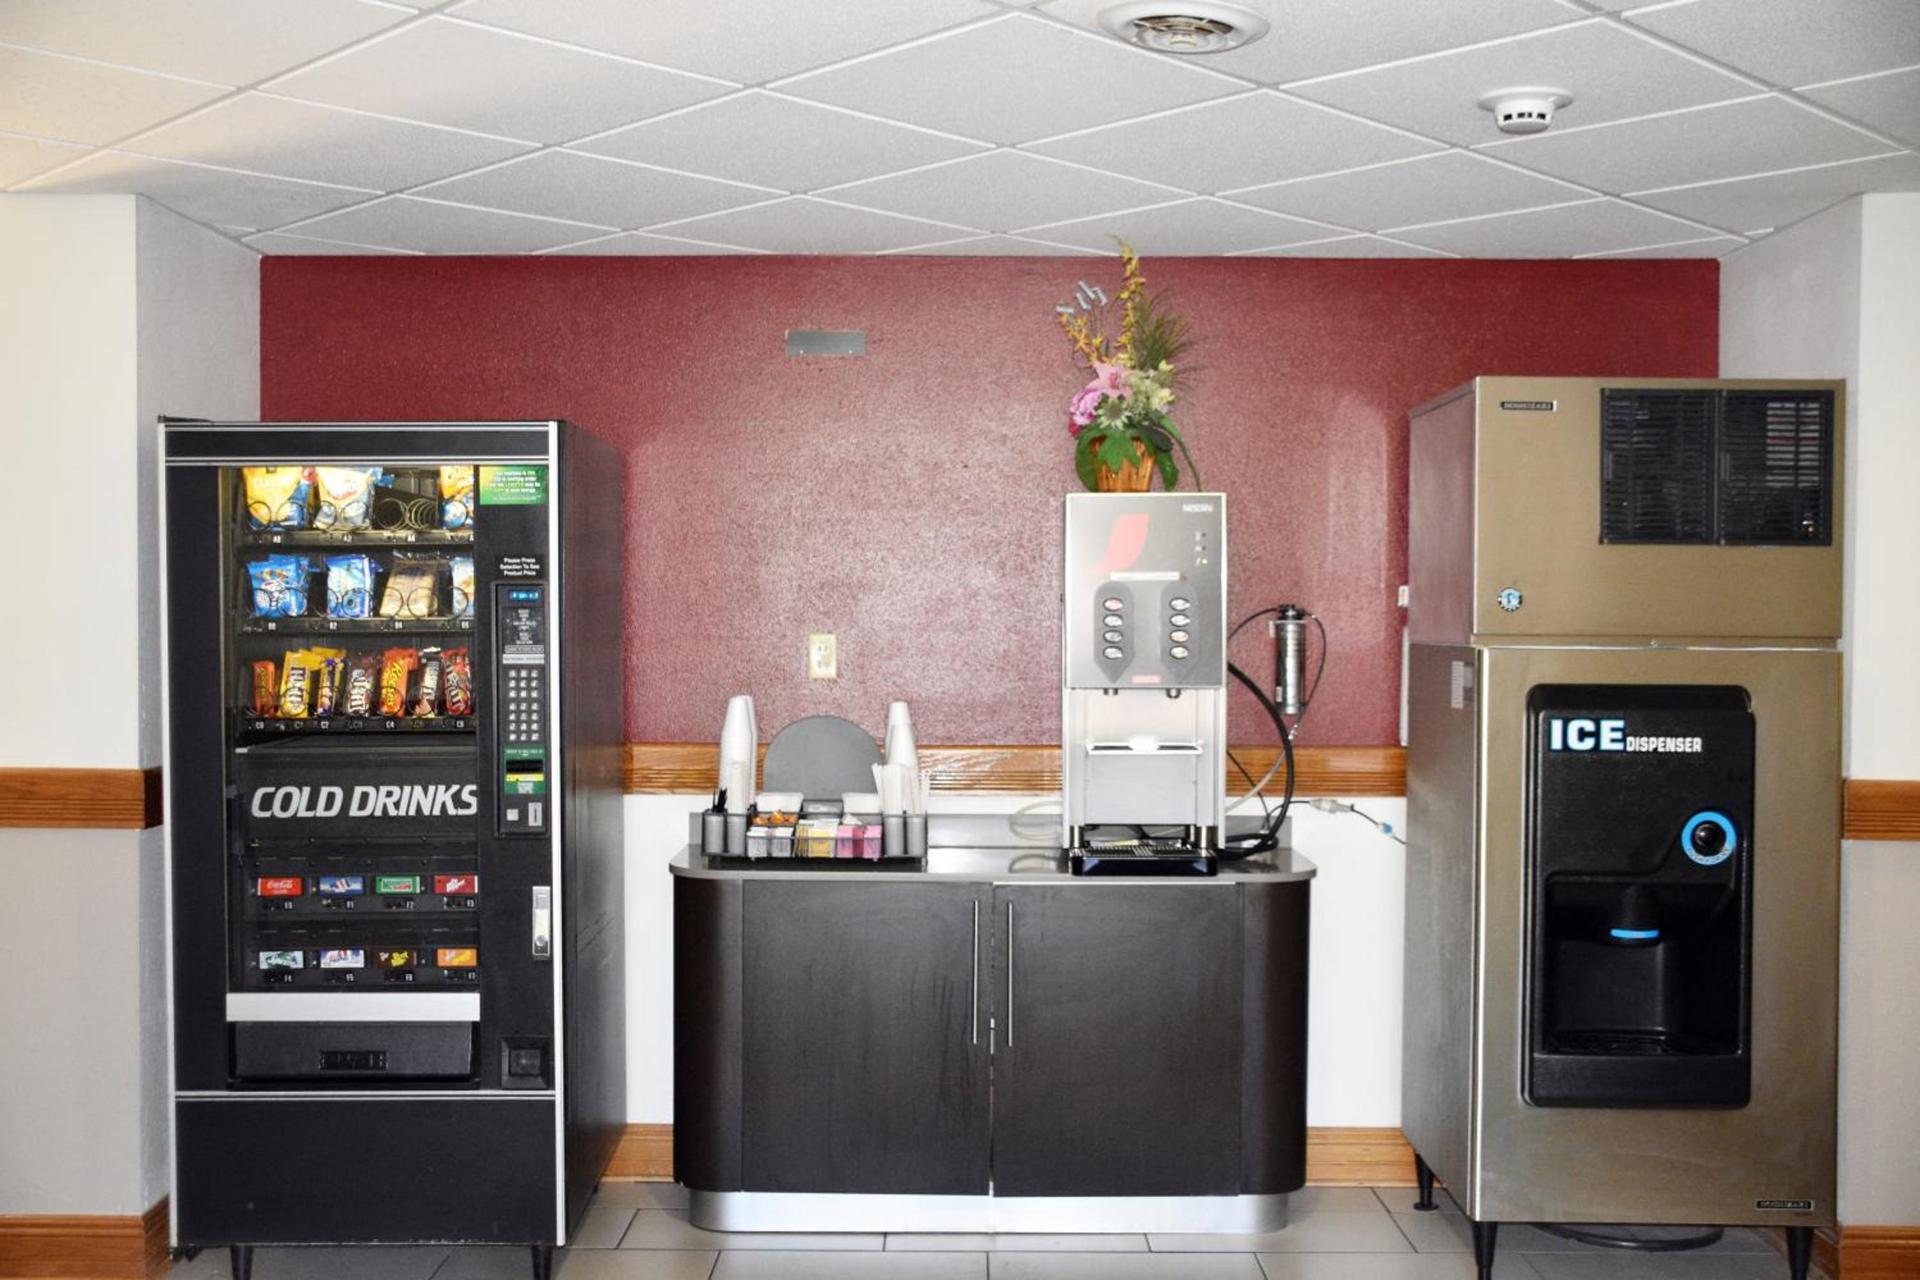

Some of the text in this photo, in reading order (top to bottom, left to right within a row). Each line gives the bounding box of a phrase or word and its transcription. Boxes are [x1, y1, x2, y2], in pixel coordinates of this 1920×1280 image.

[1551, 719, 1702, 752] ICE DISPENSER
[251, 784, 478, 818] COLD DRINKS
